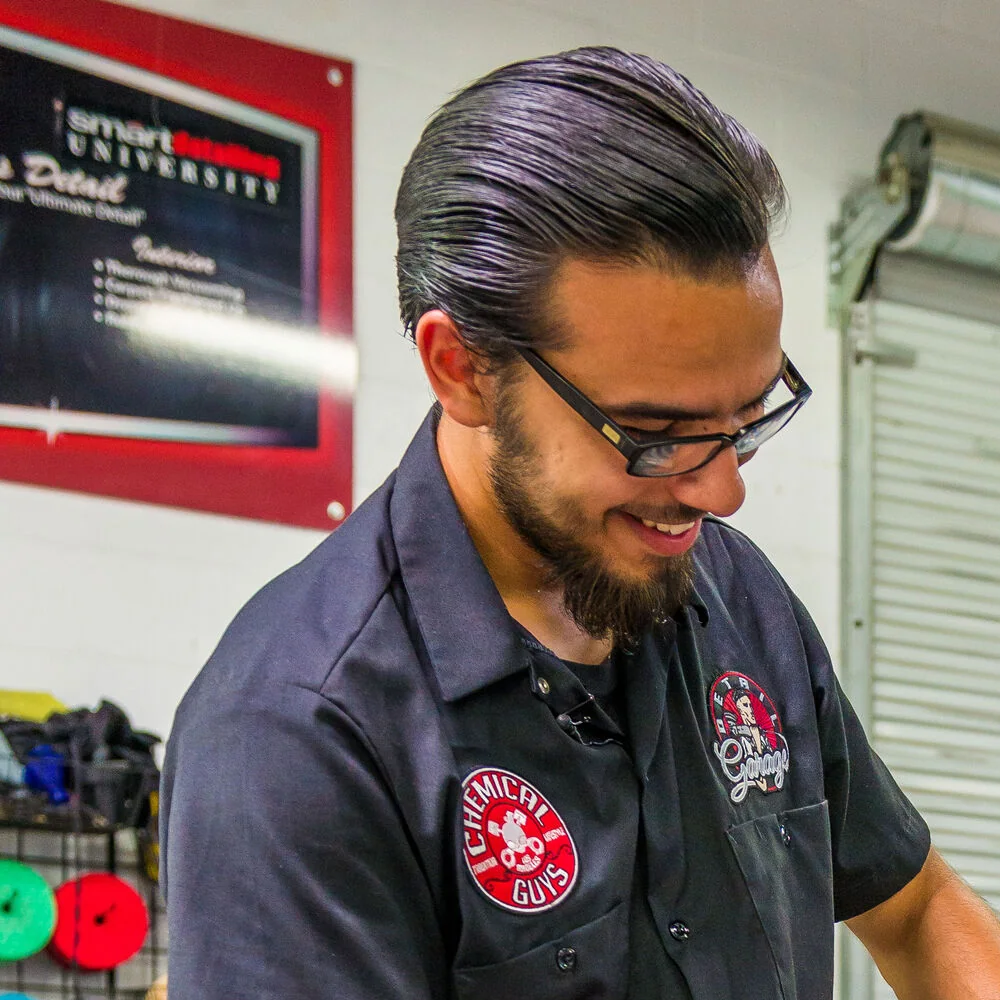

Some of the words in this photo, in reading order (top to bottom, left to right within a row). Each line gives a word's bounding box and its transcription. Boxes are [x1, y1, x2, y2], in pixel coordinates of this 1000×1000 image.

[66, 130, 282, 206] UNIVERSITY
[463, 773, 550, 858] CHEMICAL
[512, 863, 569, 906] GUYS
